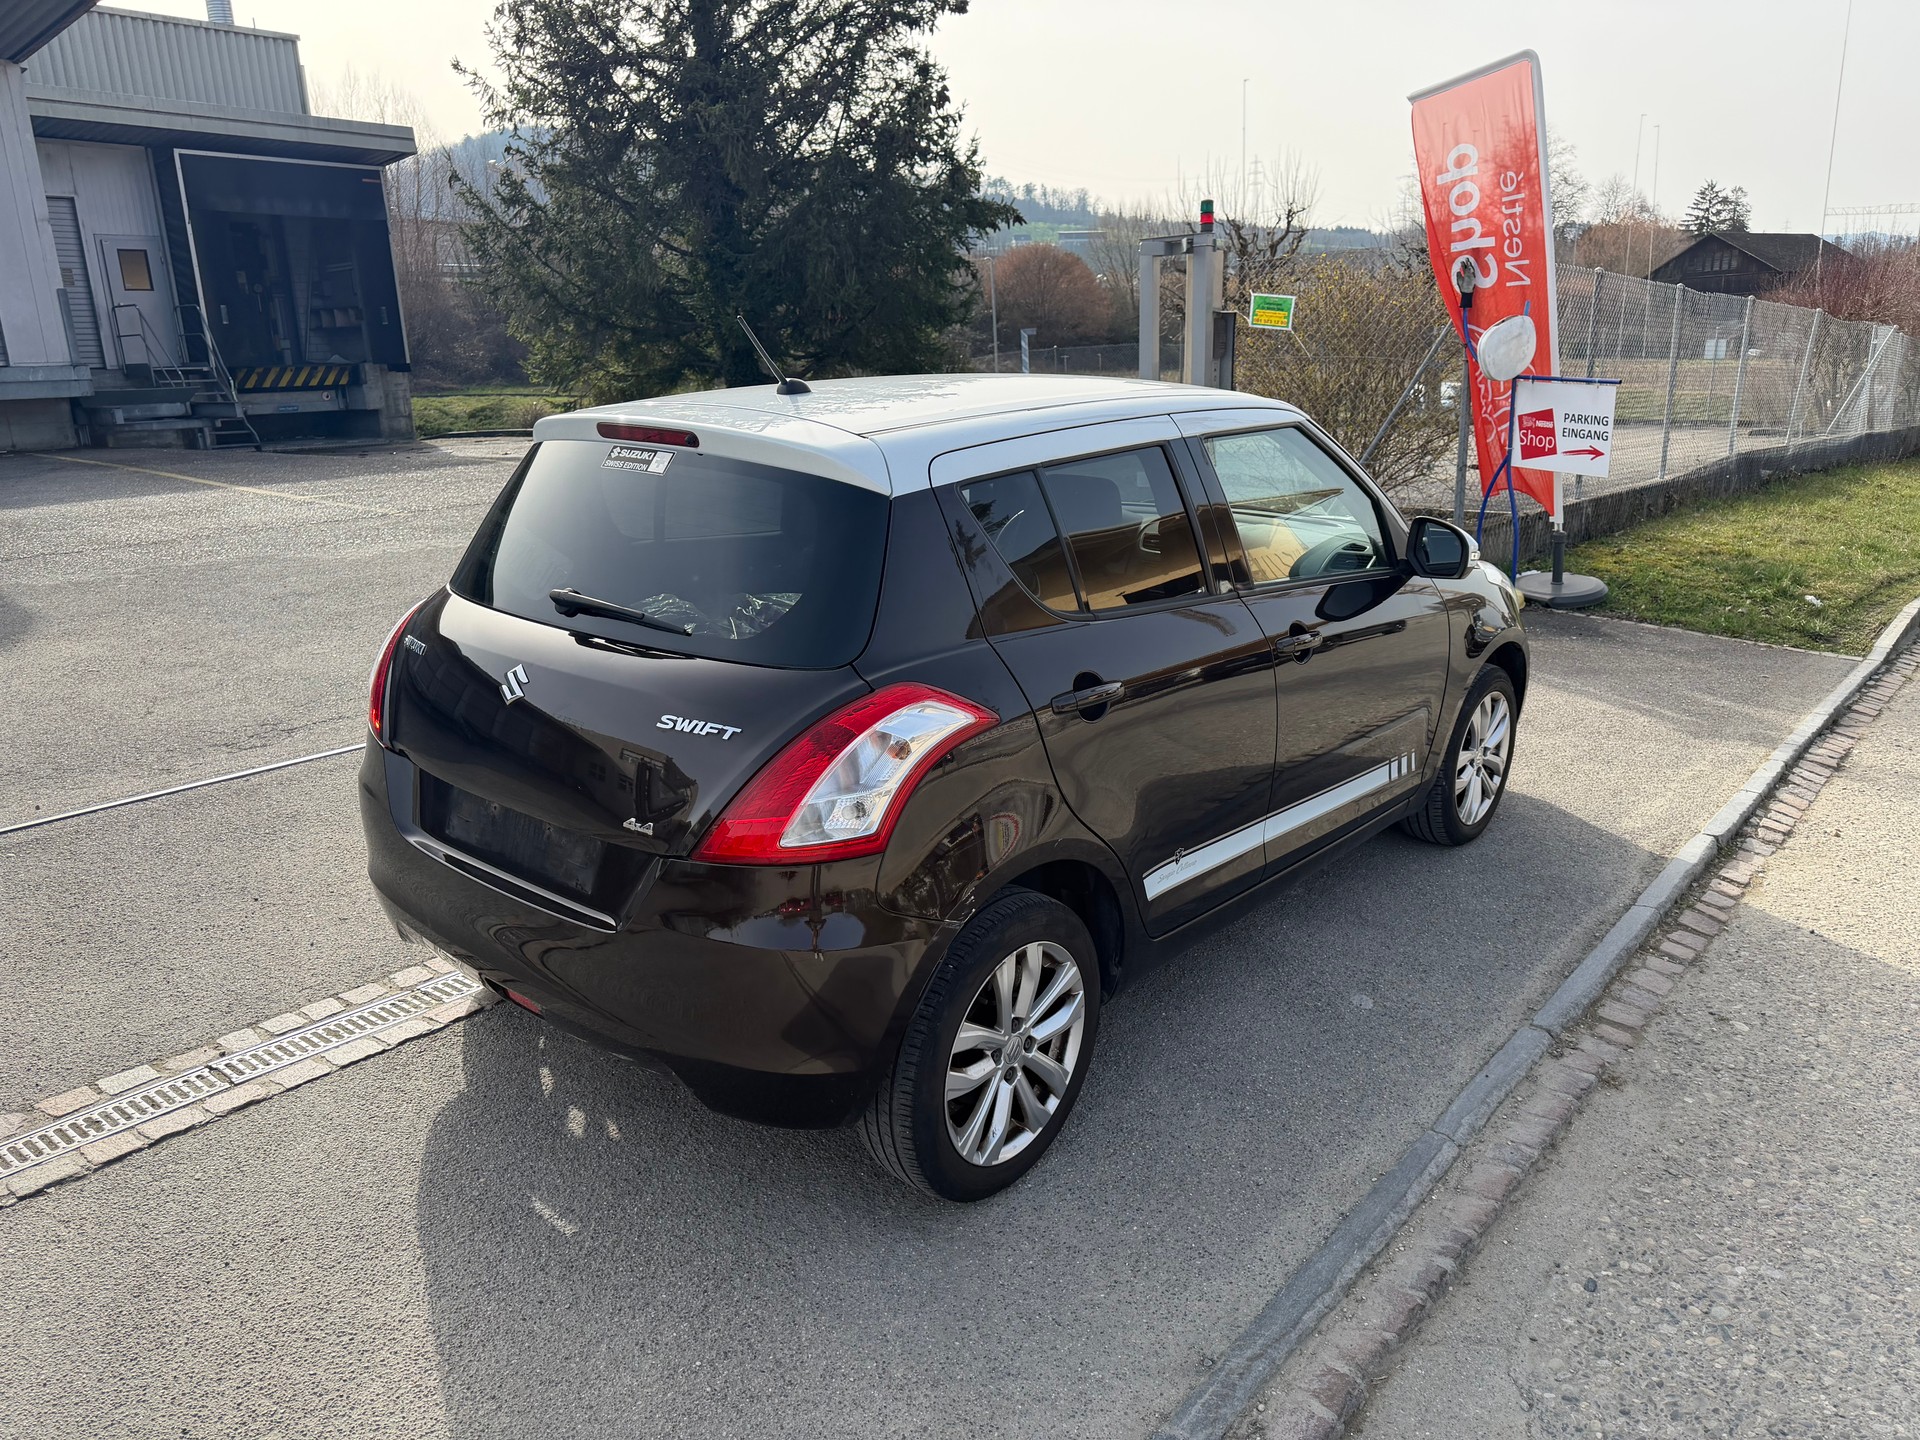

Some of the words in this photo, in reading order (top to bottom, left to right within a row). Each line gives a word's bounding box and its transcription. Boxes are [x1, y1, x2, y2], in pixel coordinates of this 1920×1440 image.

[1563, 412, 1609, 427] PARKING
[1519, 429, 1555, 452] Shop
[1562, 427, 1609, 442] EINGANG
[619, 449, 655, 460] SUZUKI
[604, 459, 624, 468] SWISS
[623, 461, 648, 471] EDITION
[655, 714, 742, 740] SWIFT
